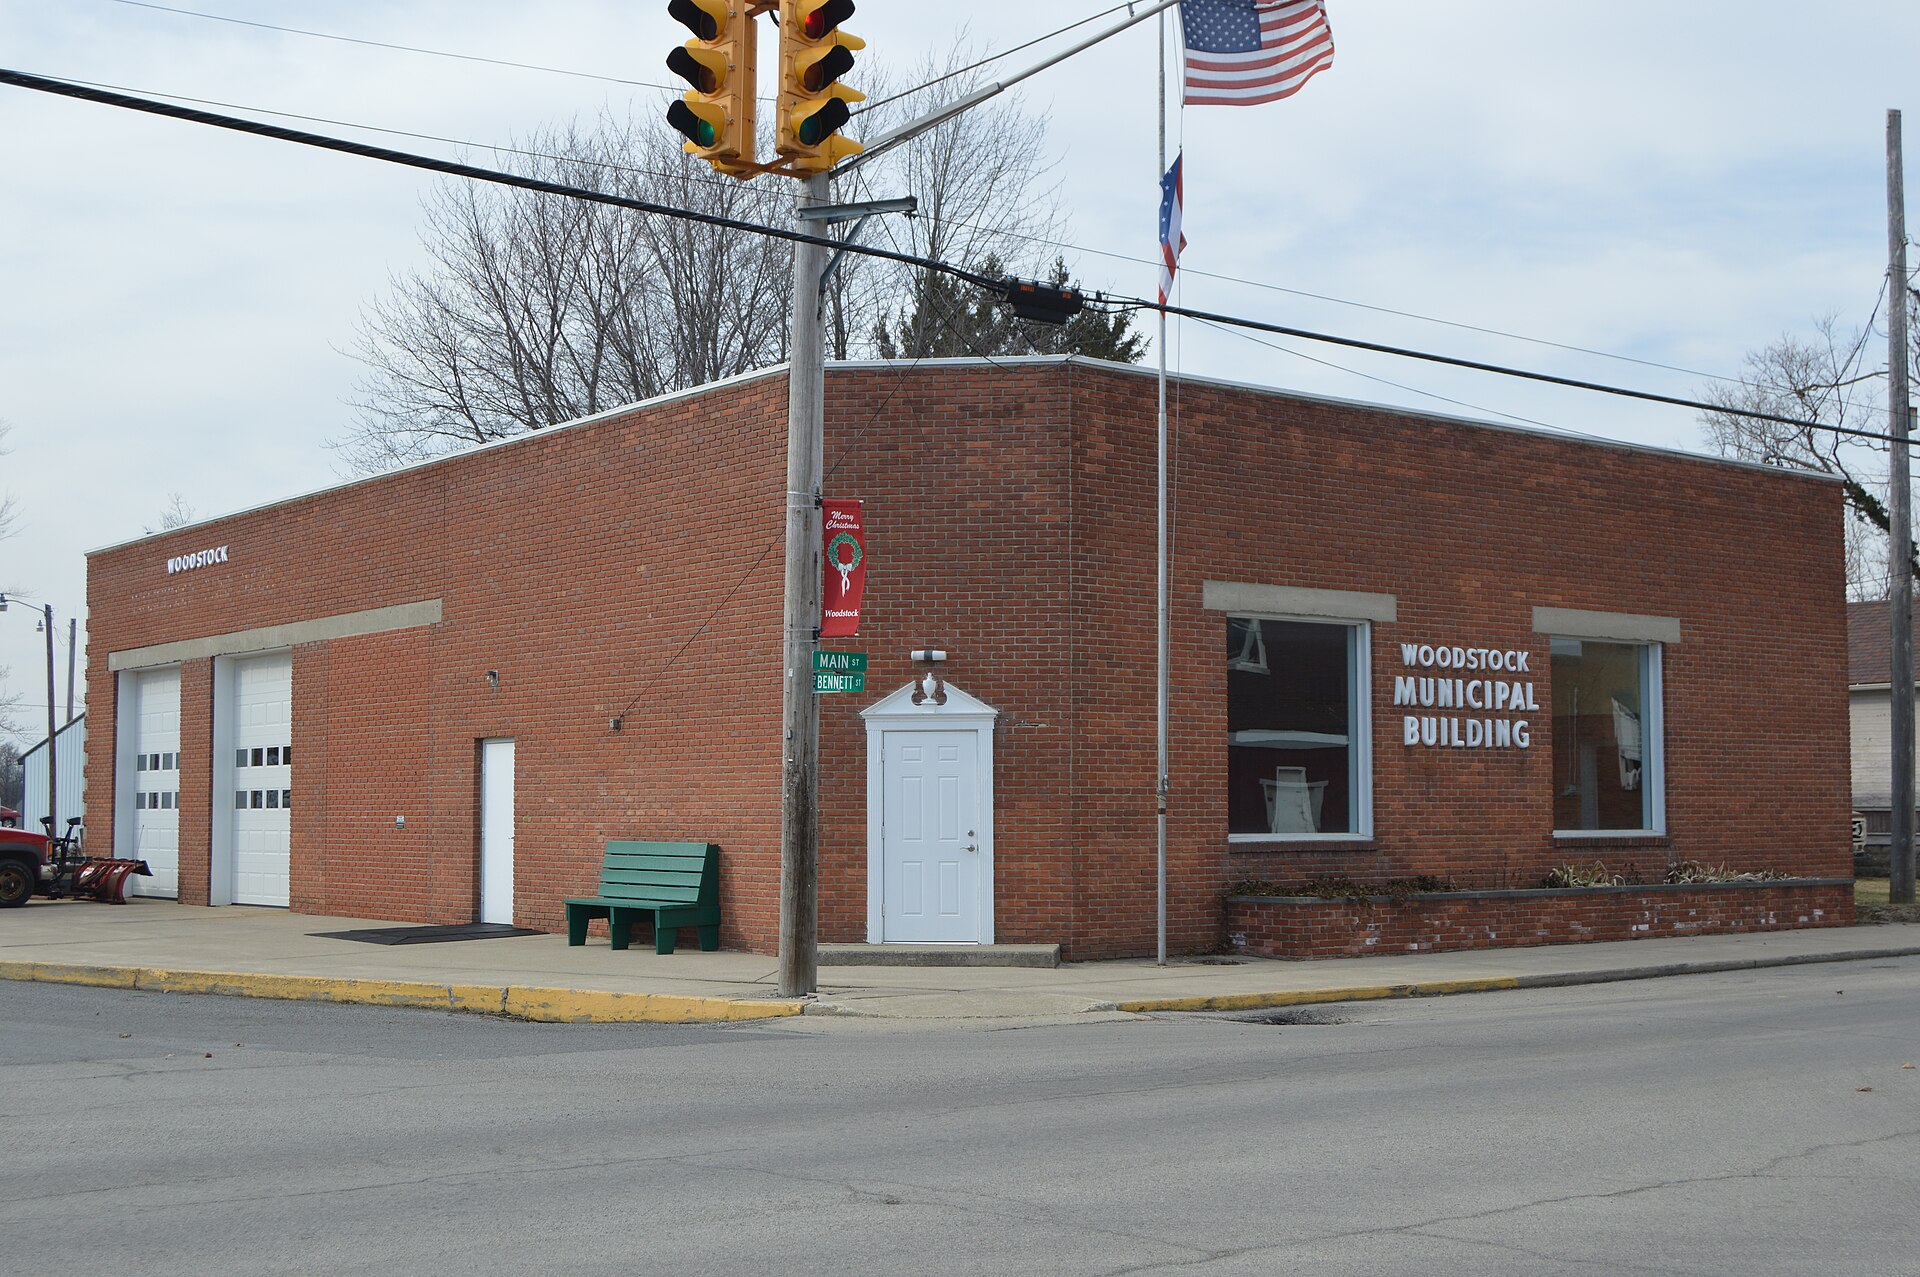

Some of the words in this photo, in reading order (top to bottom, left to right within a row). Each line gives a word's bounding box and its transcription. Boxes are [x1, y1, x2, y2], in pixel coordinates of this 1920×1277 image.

[831, 511, 854, 522] Merry
[826, 520, 860, 530] Christmas
[167, 545, 229, 574] WOODSTOCK
[825, 609, 859, 617] Woodstock
[820, 654, 849, 668] MAIN
[1401, 643, 1530, 672] WOODSTOCK
[817, 675, 853, 689] BENNETT
[855, 678, 861, 687] ST
[1394, 676, 1540, 711] MUNICIPAL
[1404, 716, 1530, 749] BUILDING
